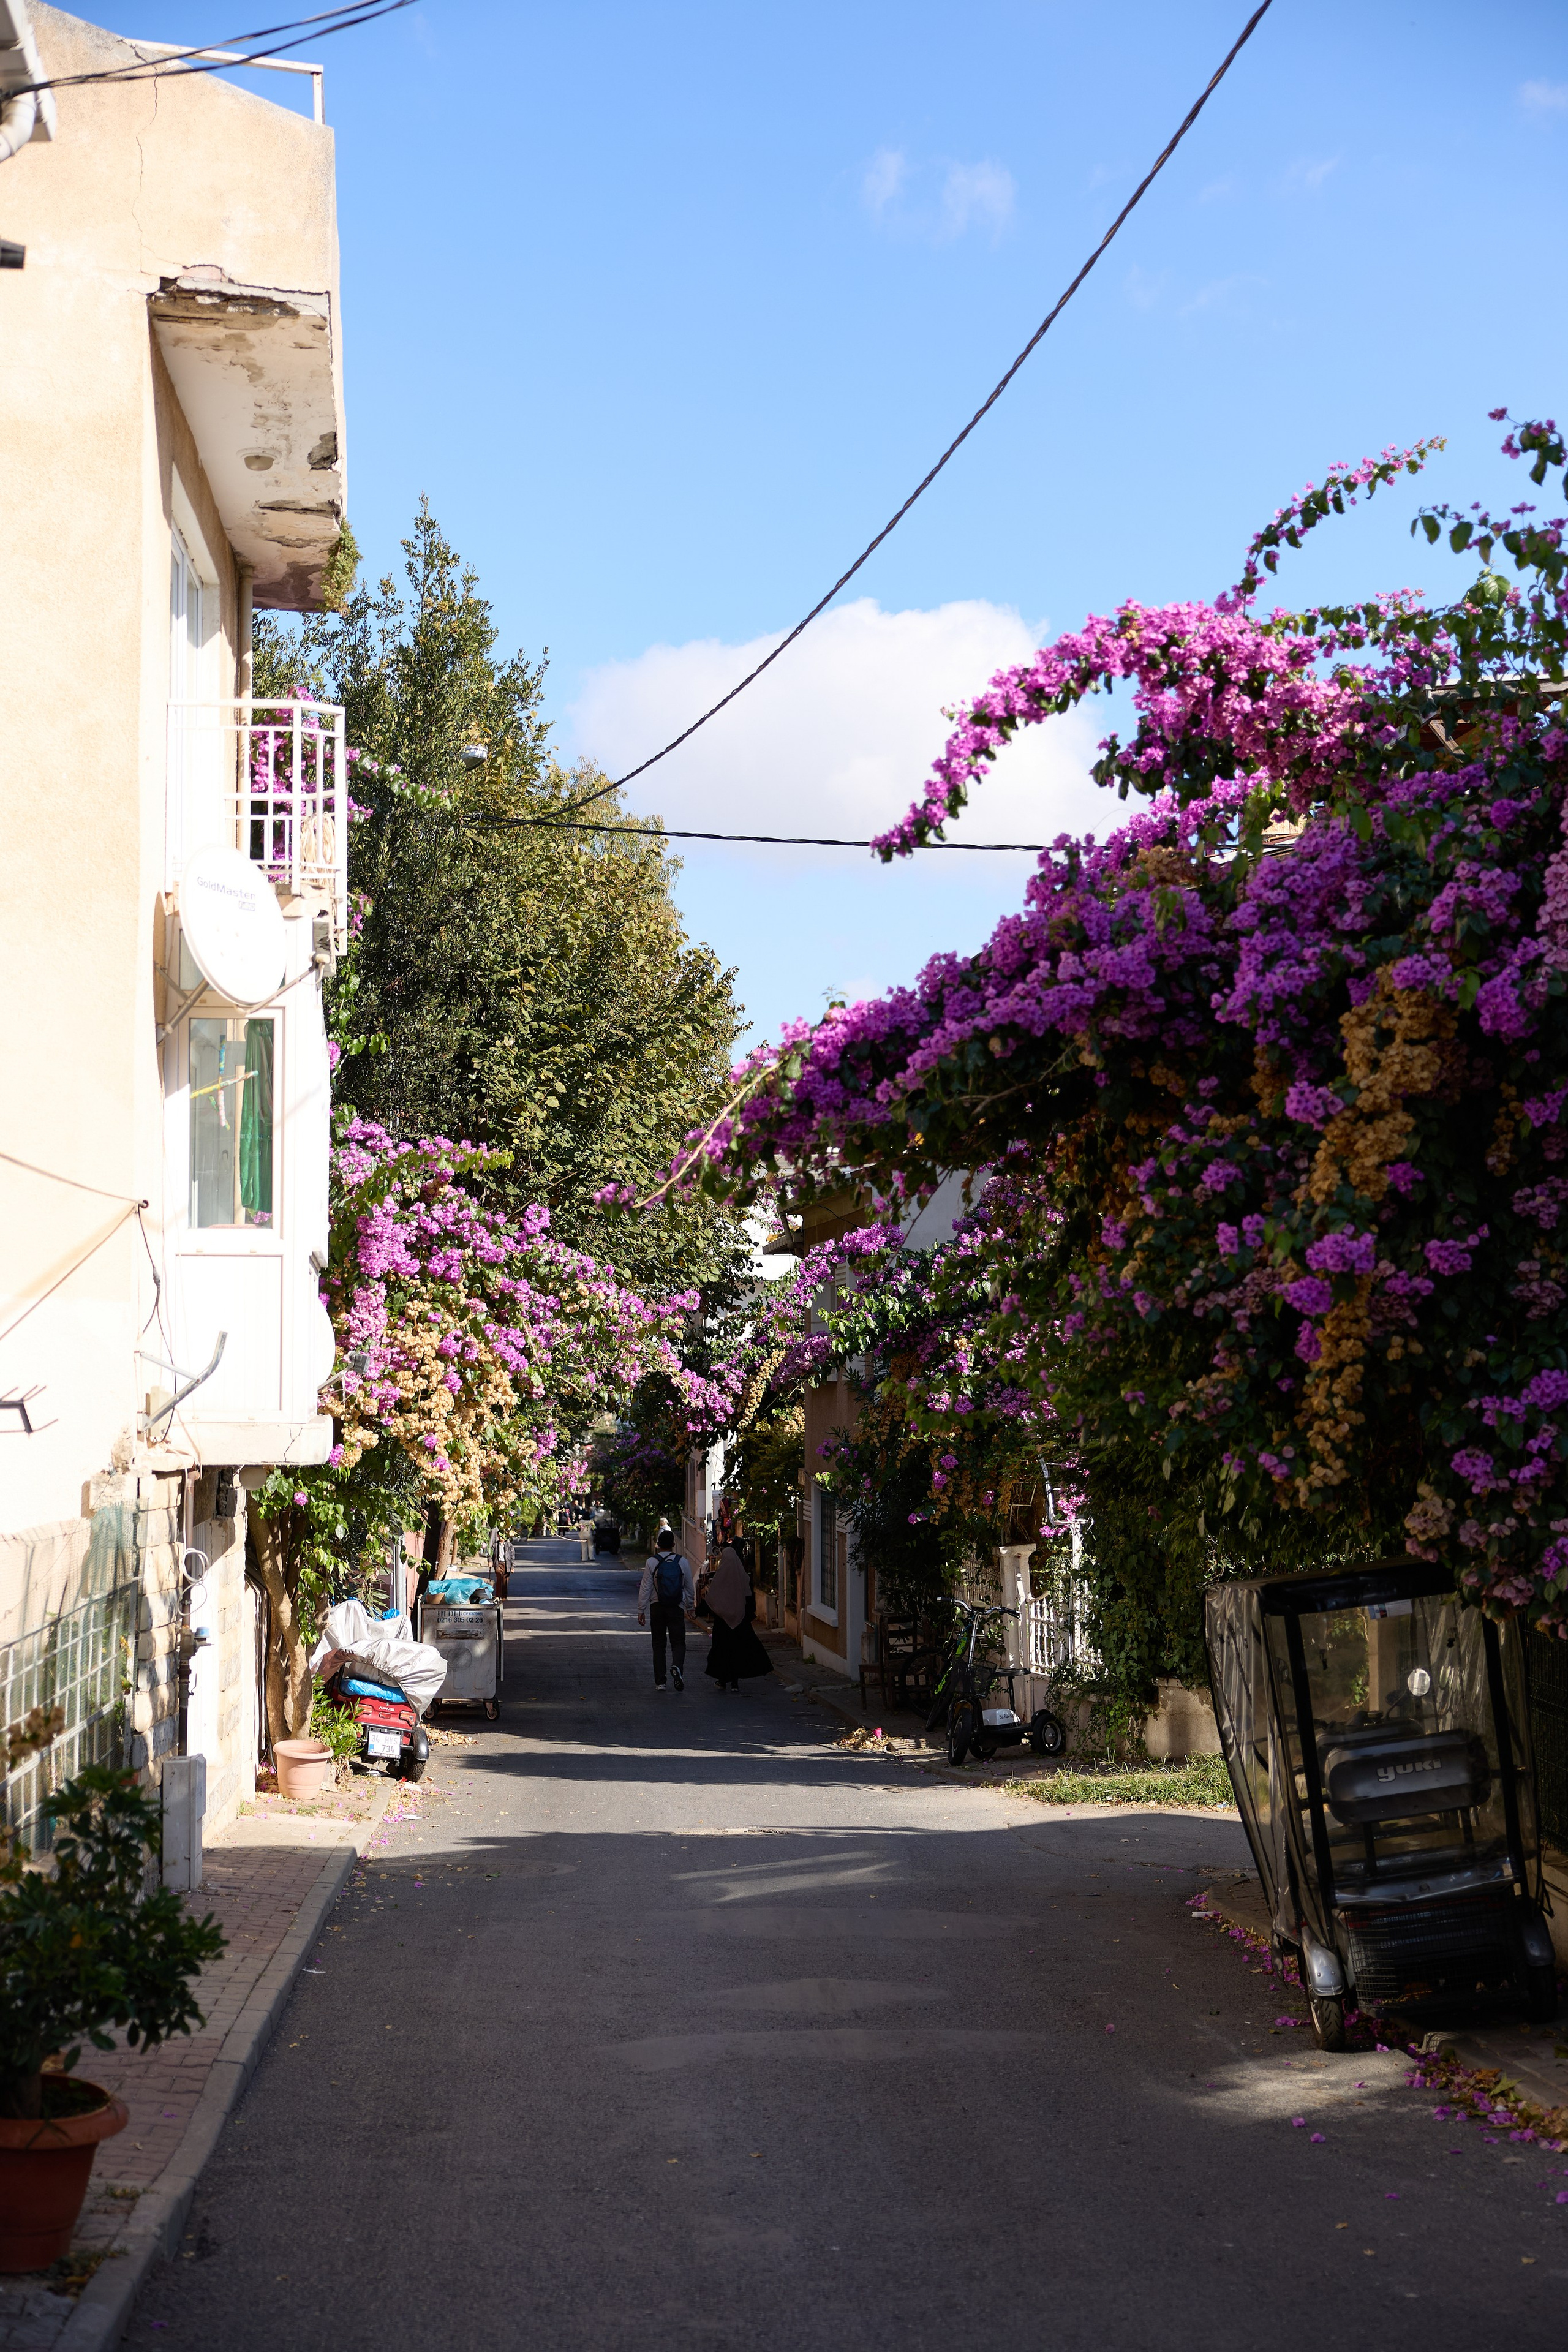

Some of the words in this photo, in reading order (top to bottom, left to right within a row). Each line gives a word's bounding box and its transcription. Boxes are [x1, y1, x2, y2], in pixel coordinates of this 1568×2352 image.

[197, 876, 255, 900] GoldMaster
[382, 1744, 394, 1753] 734
[385, 1736, 398, 1745] HYS
[1376, 1758, 1442, 1782] yuki
